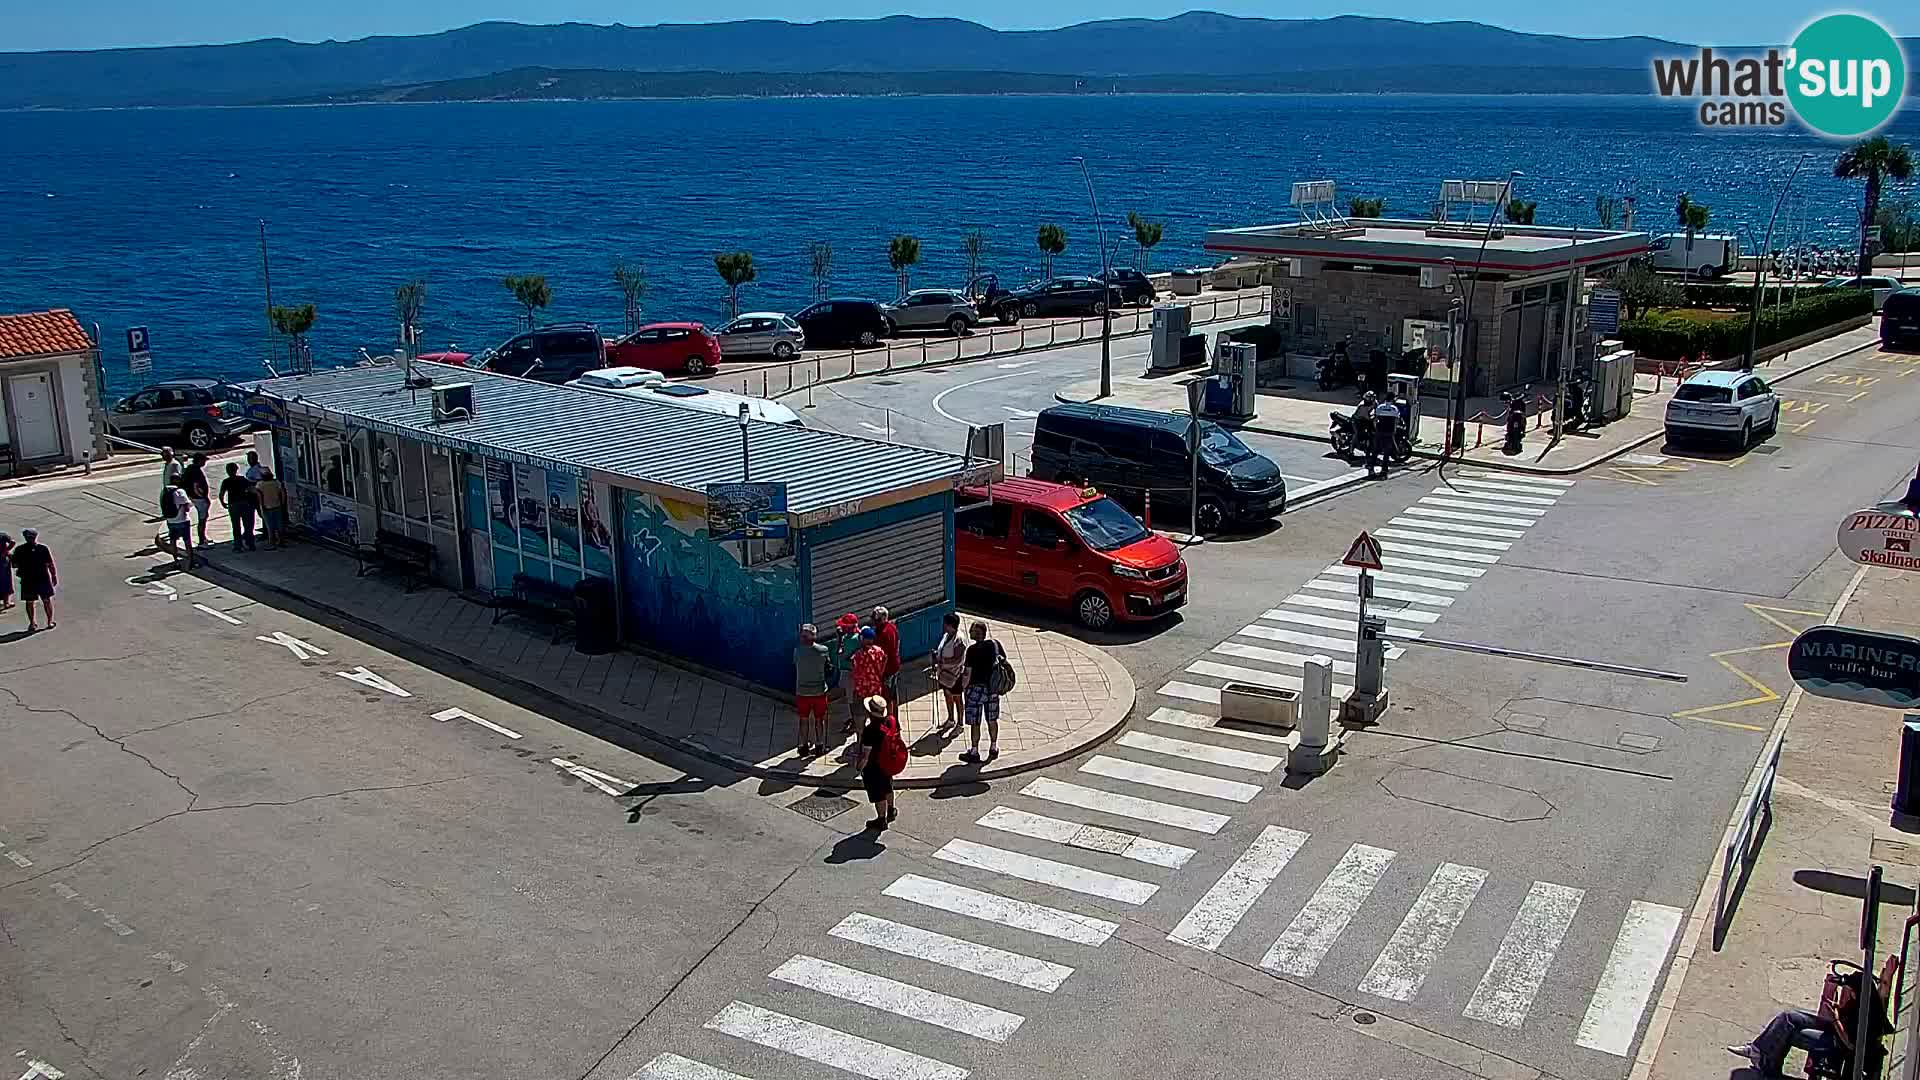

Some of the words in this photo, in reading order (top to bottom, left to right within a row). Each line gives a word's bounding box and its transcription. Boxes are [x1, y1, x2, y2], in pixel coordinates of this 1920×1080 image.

[131, 331, 143, 348] P
[479, 446, 494, 457] BUS
[494, 448, 527, 465] STATION
[528, 456, 555, 470] TICKET
[556, 462, 584, 477] OFFICE
[1848, 514, 1920, 533] PIZZE
[1829, 661, 1866, 674] caffe
[1871, 665, 1897, 680] bar
